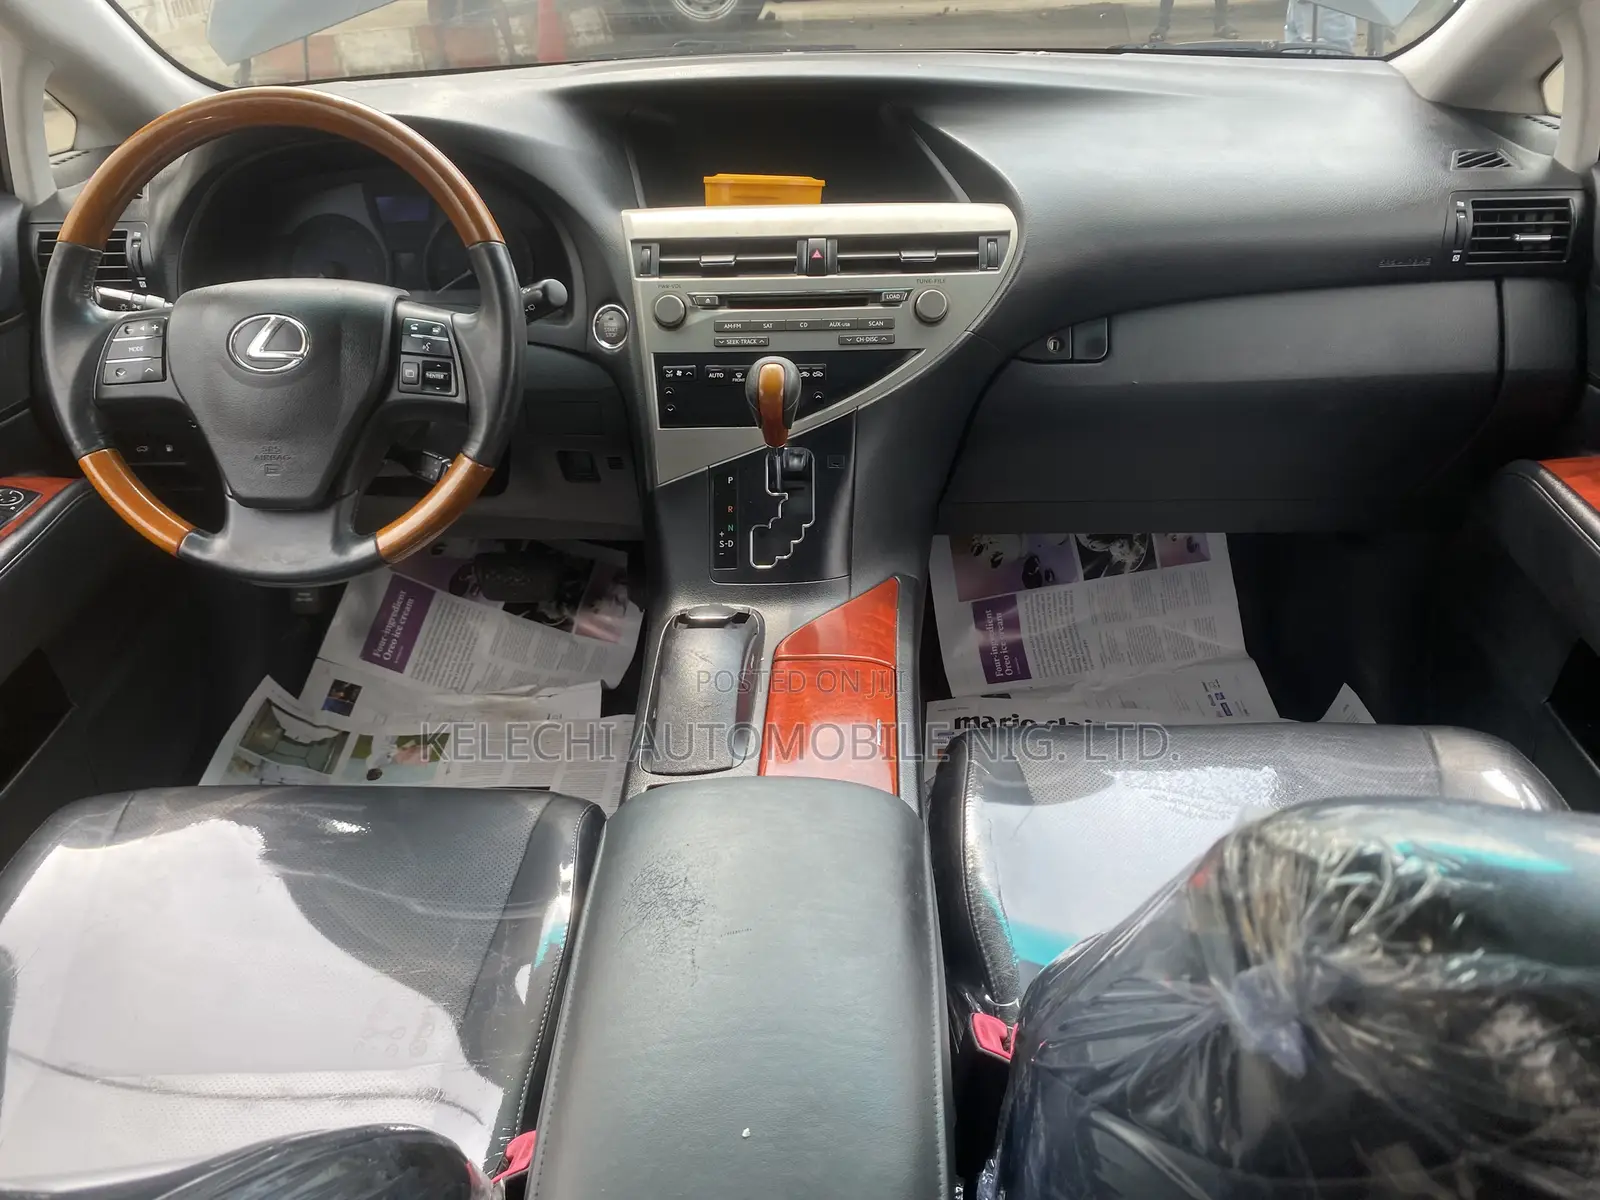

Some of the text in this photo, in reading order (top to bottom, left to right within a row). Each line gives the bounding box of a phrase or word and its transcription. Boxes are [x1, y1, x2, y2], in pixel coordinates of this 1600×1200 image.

[727, 476, 734, 484] P
[727, 505, 734, 513] R
[727, 524, 734, 532] N
[382, 638, 398, 661] Oreo
[399, 597, 415, 625] cream
[985, 608, 1004, 678] Four-ingedient
[1003, 654, 1014, 676] Oreo
